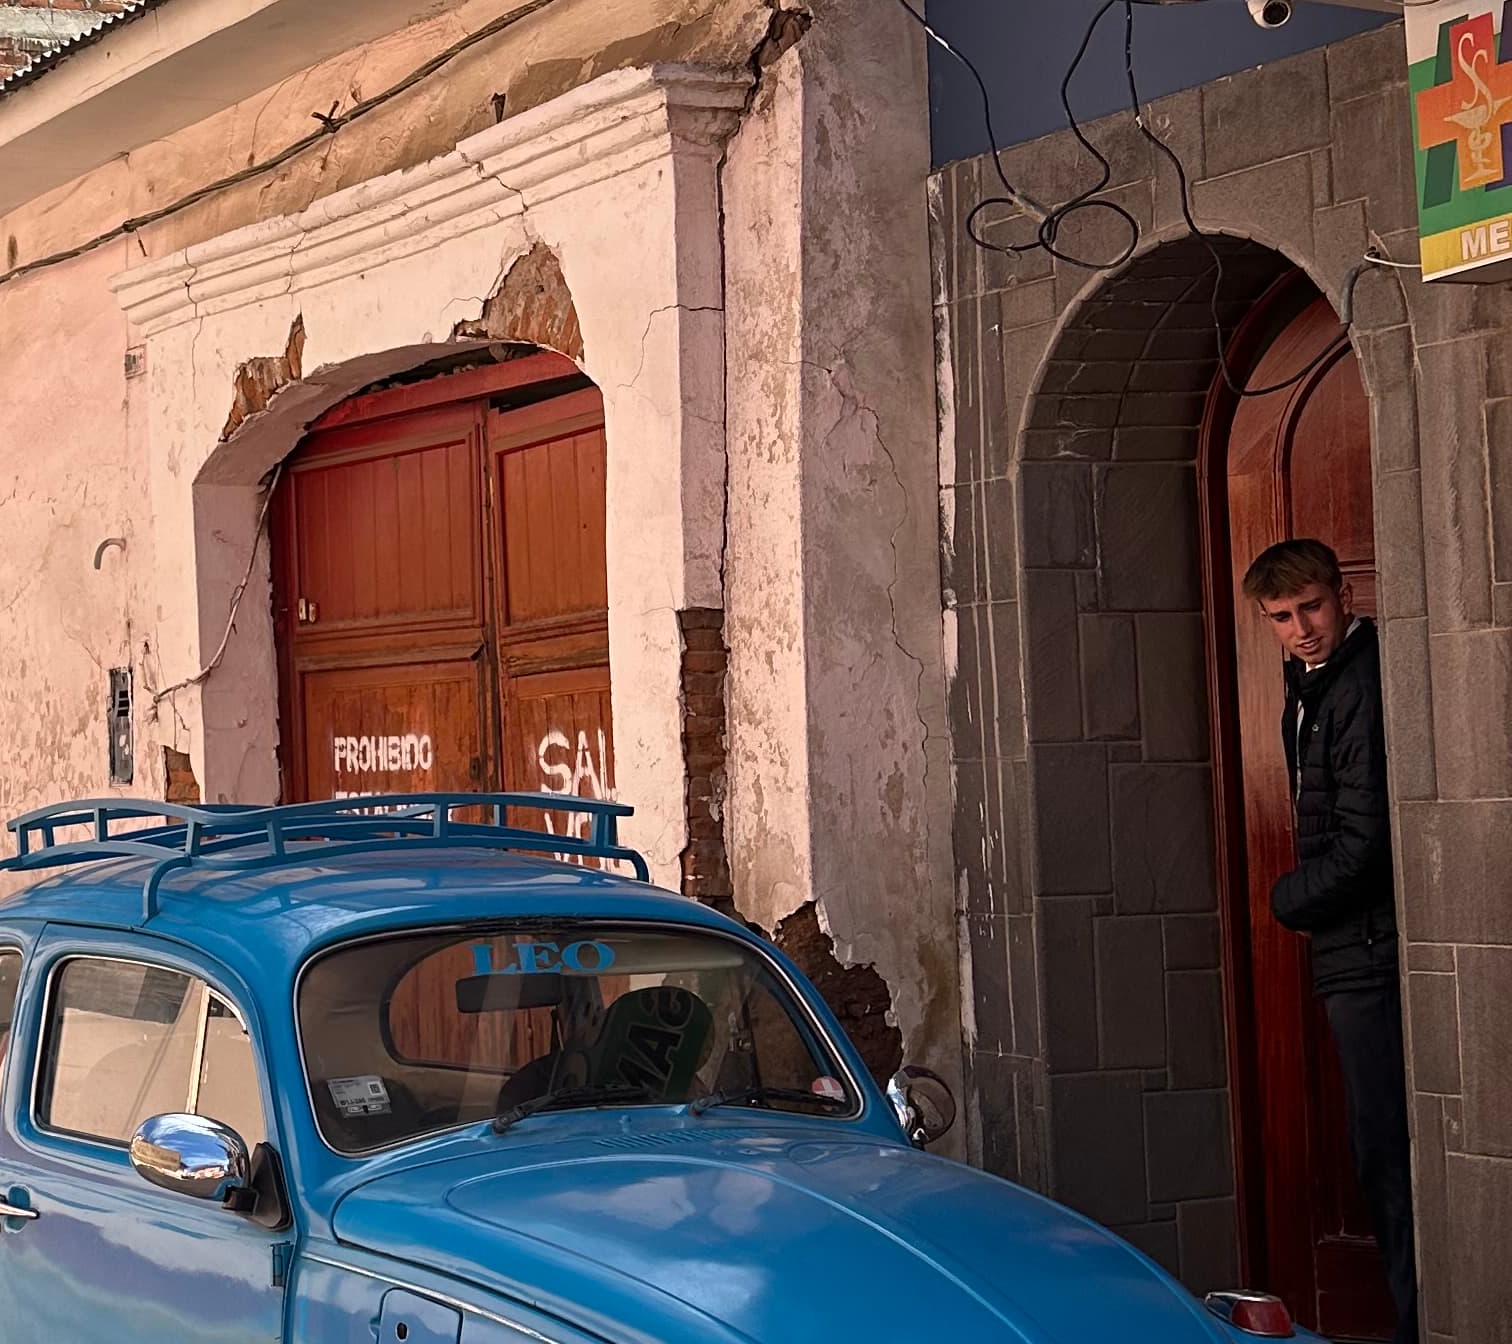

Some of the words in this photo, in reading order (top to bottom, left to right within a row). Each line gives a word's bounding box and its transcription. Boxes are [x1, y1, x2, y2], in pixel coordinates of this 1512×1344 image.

[1461, 220, 1511, 261] ME
[334, 733, 433, 774] PROHIBIDO
[469, 940, 617, 978] LEO
